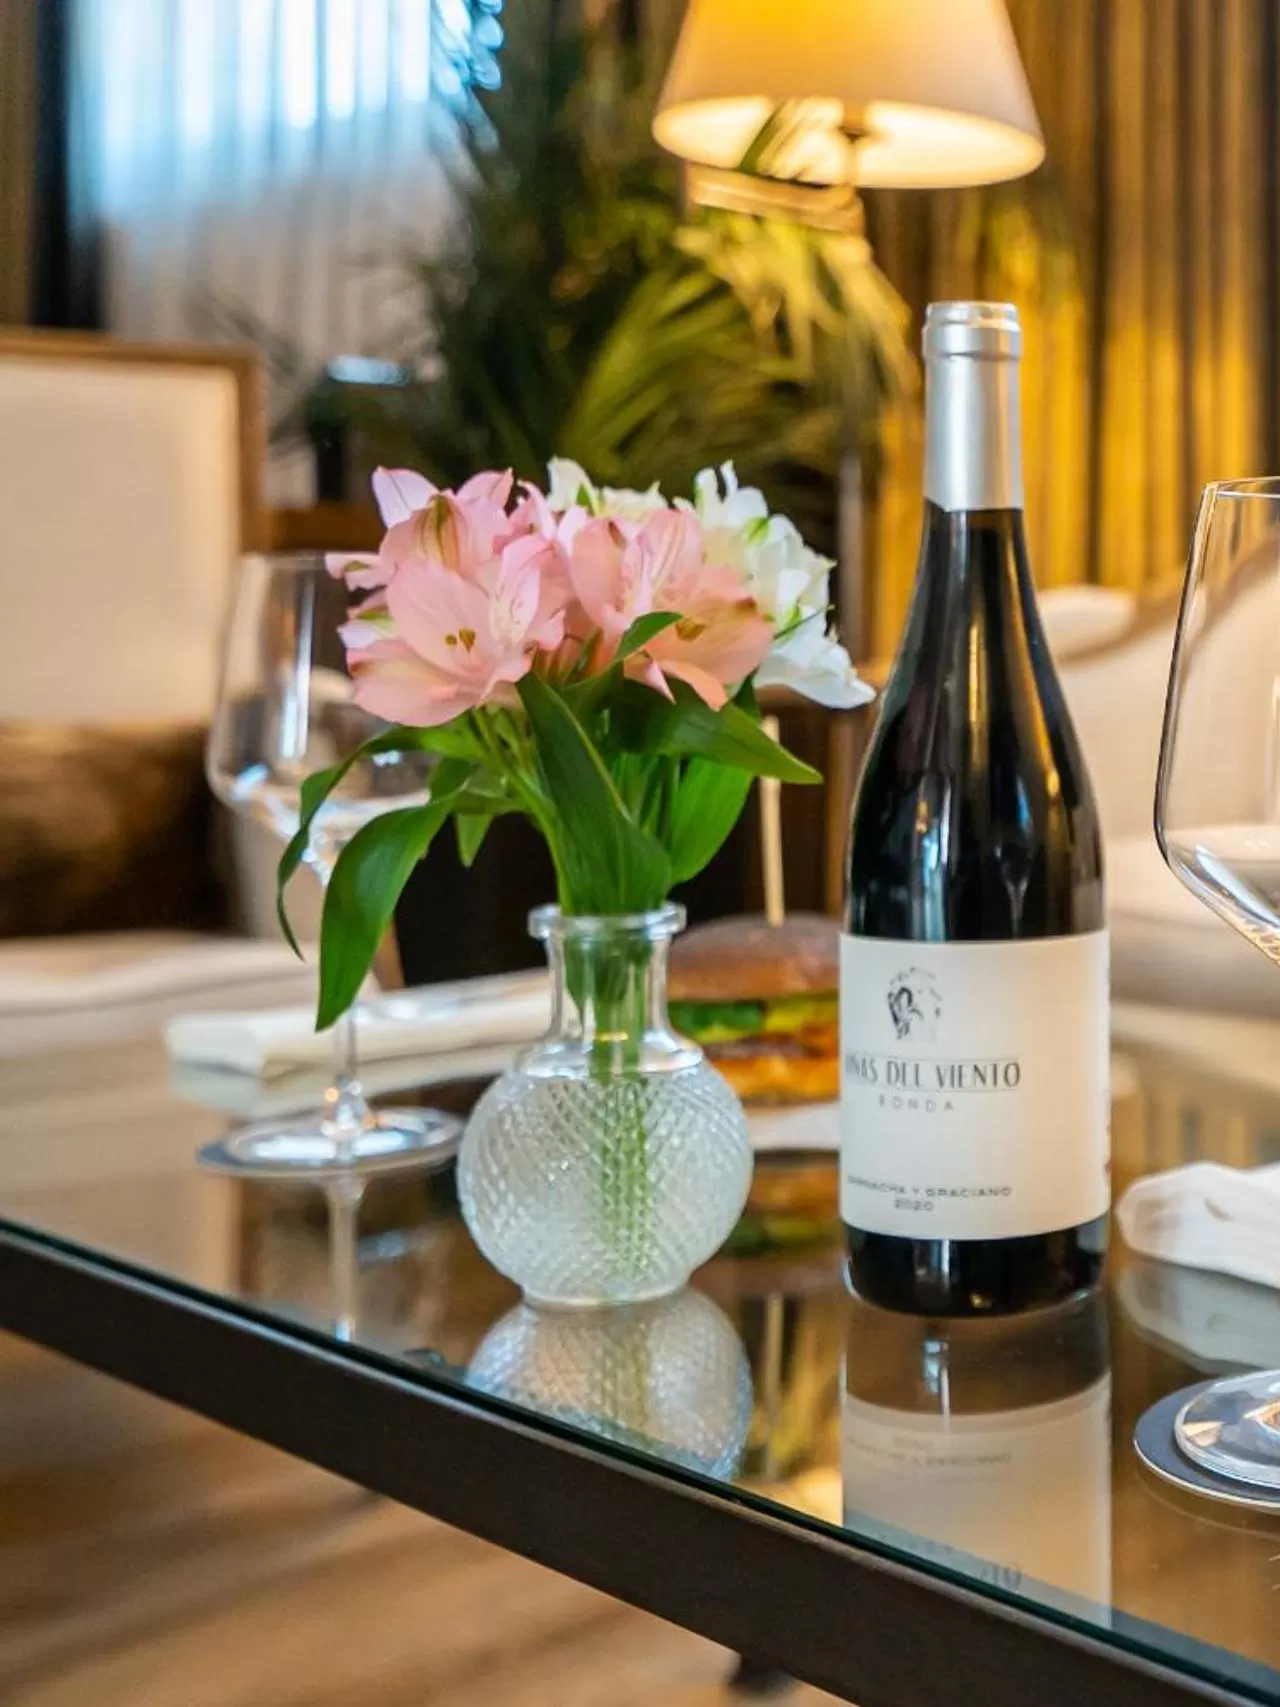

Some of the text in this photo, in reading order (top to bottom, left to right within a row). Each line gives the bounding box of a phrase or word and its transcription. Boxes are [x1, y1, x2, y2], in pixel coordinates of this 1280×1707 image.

[887, 1060, 923, 1088] DEL
[936, 1062, 1020, 1088] VIENTO
[878, 1094, 953, 1112] RONDA
[927, 1186, 1012, 1198] GRACIANO
